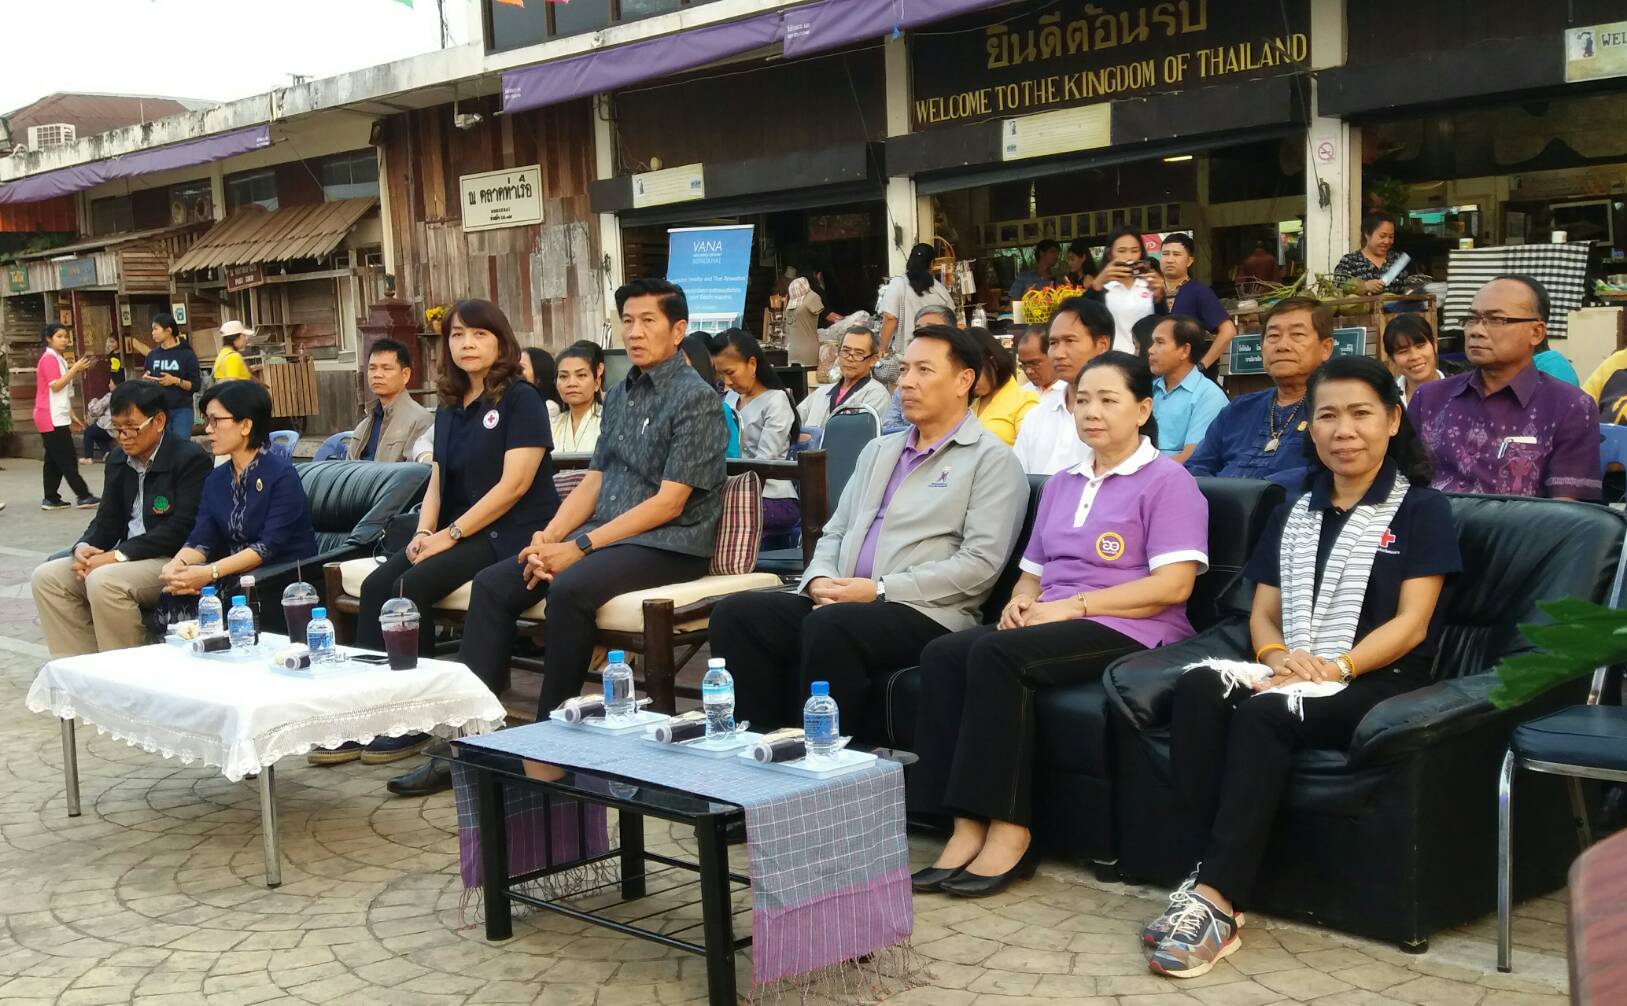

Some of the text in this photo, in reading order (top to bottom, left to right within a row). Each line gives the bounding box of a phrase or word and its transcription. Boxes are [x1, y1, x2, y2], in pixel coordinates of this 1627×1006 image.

[986, 0, 1208, 70] ยินดีต้อนรบ
[915, 33, 1308, 124] WELCOME TO THE KINGDOM OF THAILAND
[693, 240, 722, 252] VANA
[153, 359, 180, 371] FILA
